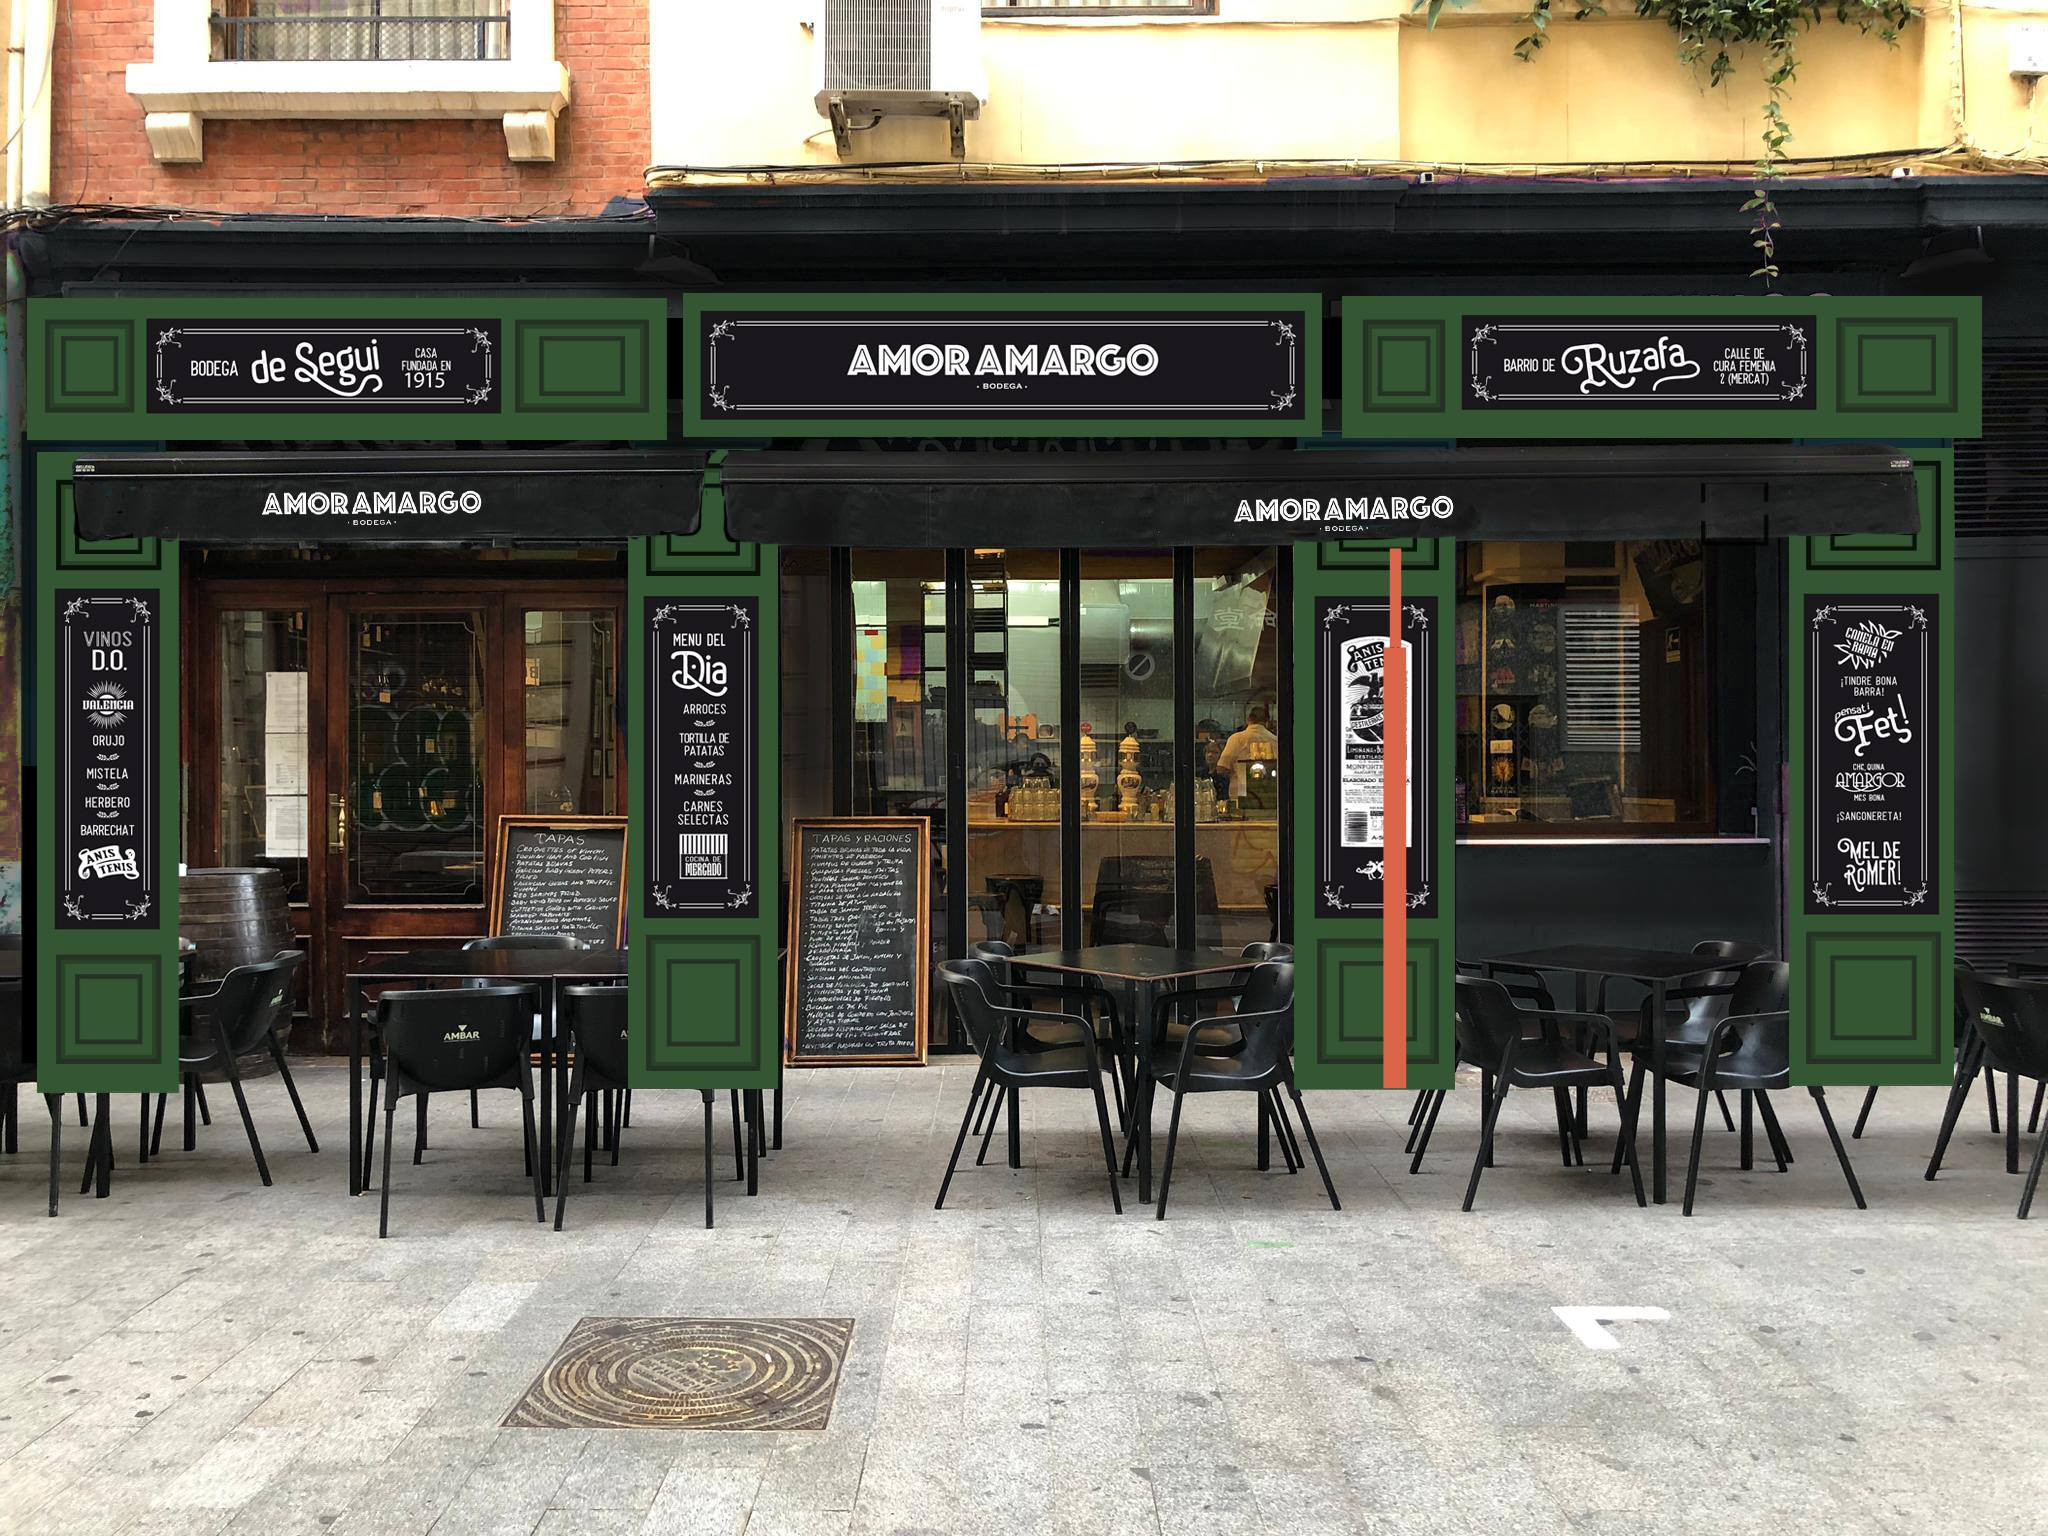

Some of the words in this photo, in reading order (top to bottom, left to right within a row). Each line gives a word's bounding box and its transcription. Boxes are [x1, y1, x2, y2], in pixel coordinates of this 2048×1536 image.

[415, 348, 437, 358] CASA
[1725, 348, 1750, 359] CALLE
[1754, 348, 1764, 359] DE
[402, 360, 437, 371] FUNDADA
[441, 360, 451, 371] EN
[847, 344, 970, 376] AMOR
[974, 344, 1158, 376] AMARGO
[1504, 359, 1538, 372] BARRIO
[1543, 359, 1555, 372] DE
[1559, 336, 1702, 396] Ruzafa
[1714, 360, 1736, 371] CURA
[1740, 360, 1776, 372] FEMENIA
[191, 360, 238, 376] BODEGA
[251, 350, 286, 383] de
[294, 339, 383, 397] Segui
[405, 372, 444, 388] 1915
[1720, 373, 1724, 384] 2
[1728, 373, 1769, 386] (MERCAT)
[262, 492, 349, 515] AMOR
[352, 491, 481, 514] AMARGO
[1234, 498, 1321, 522] AMOR
[1324, 496, 1453, 520] AMARGO
[84, 631, 131, 647] VINOS
[673, 633, 701, 646] MENU
[707, 633, 725, 646] DEL
[1354, 644, 1382, 660] ANIS
[1852, 641, 1878, 658] RAMA
[1881, 640, 1894, 652] EN
[92, 649, 127, 670] D.O.
[1876, 676, 1897, 686] BONA
[1854, 687, 1884, 696] BARRA!
[683, 704, 726, 714] ARROCES
[1835, 704, 1866, 722] pensat
[1835, 694, 1912, 756] Fet!
[93, 735, 124, 746] ORUJO
[679, 733, 716, 743] TORTILLA
[719, 733, 729, 743] DE
[684, 745, 724, 756] PATATAS
[87, 768, 128, 779] MISTELA
[675, 774, 732, 785] MARINERAS
[1835, 772, 1906, 792] AMARGOR
[85, 797, 130, 808] HERBERO
[684, 801, 722, 812] CARNES
[678, 814, 728, 825] SELECTAS
[81, 825, 134, 836] BARRECHAT
[534, 832, 585, 846] TAPAS
[813, 834, 851, 844] TAPAS
[864, 834, 912, 843] RACIONES
[86, 849, 116, 864] ANIS
[1838, 838, 1879, 866] MEL
[1884, 842, 1900, 858] DE
[99, 863, 133, 874] TENIS
[685, 863, 721, 876] MERCADO
[444, 1031, 480, 1040] AMBAR
